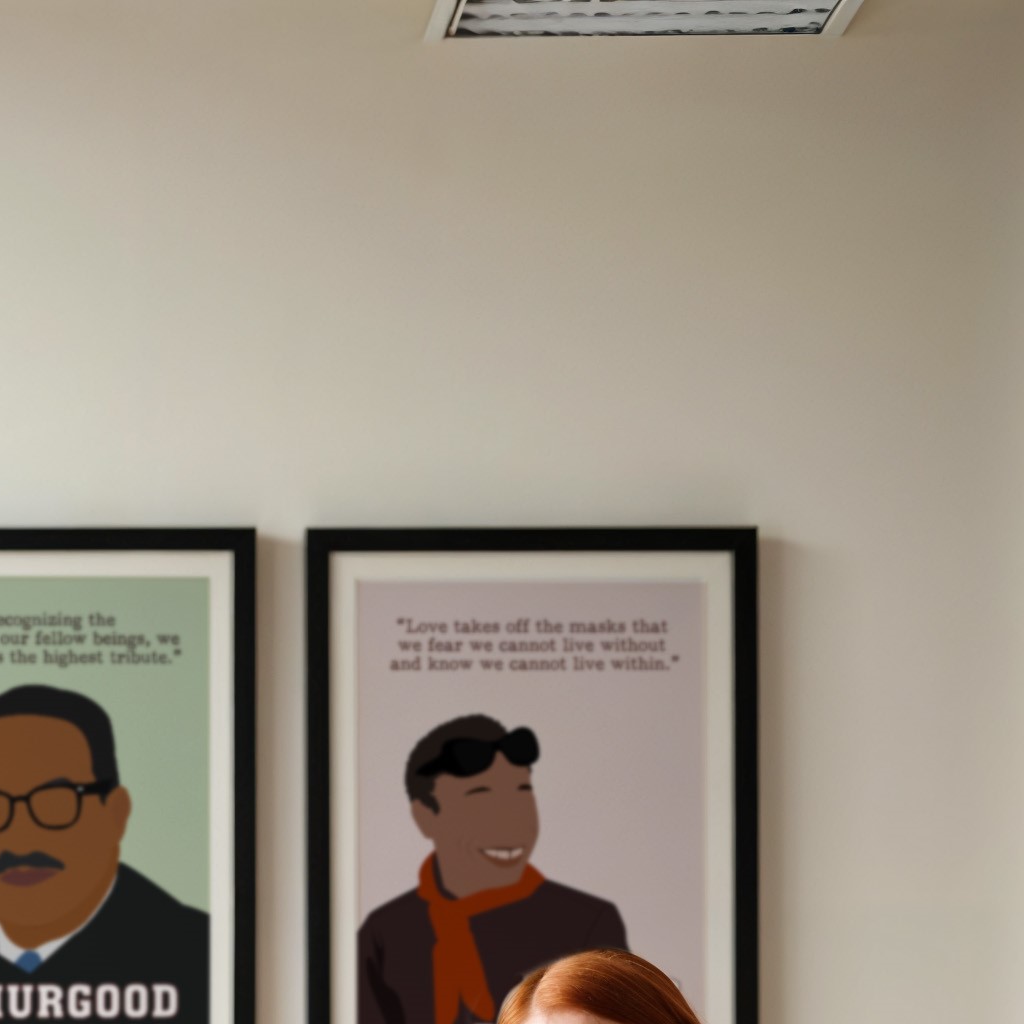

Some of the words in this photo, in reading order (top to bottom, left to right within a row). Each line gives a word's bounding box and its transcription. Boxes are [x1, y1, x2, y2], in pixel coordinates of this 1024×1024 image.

[88, 611, 116, 627] the
[396, 617, 447, 634] "Love
[453, 618, 500, 634] takes
[505, 617, 530, 634] off
[536, 617, 563, 633] the
[569, 617, 625, 633] masks
[632, 617, 668, 633] that
[0, 633, 28, 646] our
[34, 630, 87, 646] fellow
[93, 630, 151, 649] beings,
[157, 633, 181, 646] we
[398, 639, 422, 652] we
[428, 637, 463, 652] fear
[469, 639, 493, 652] we
[498, 637, 556, 652] cannot
[562, 637, 594, 652] live
[600, 637, 666, 651] without
[10, 649, 37, 664] the
[43, 649, 103, 668] highest
[110, 648, 182, 664] tribute."
[390, 656, 422, 671] and
[427, 656, 473, 671] know
[480, 658, 503, 671] we
[509, 656, 566, 671] cannot
[572, 656, 605, 671] live
[610, 655, 680, 671] within."
